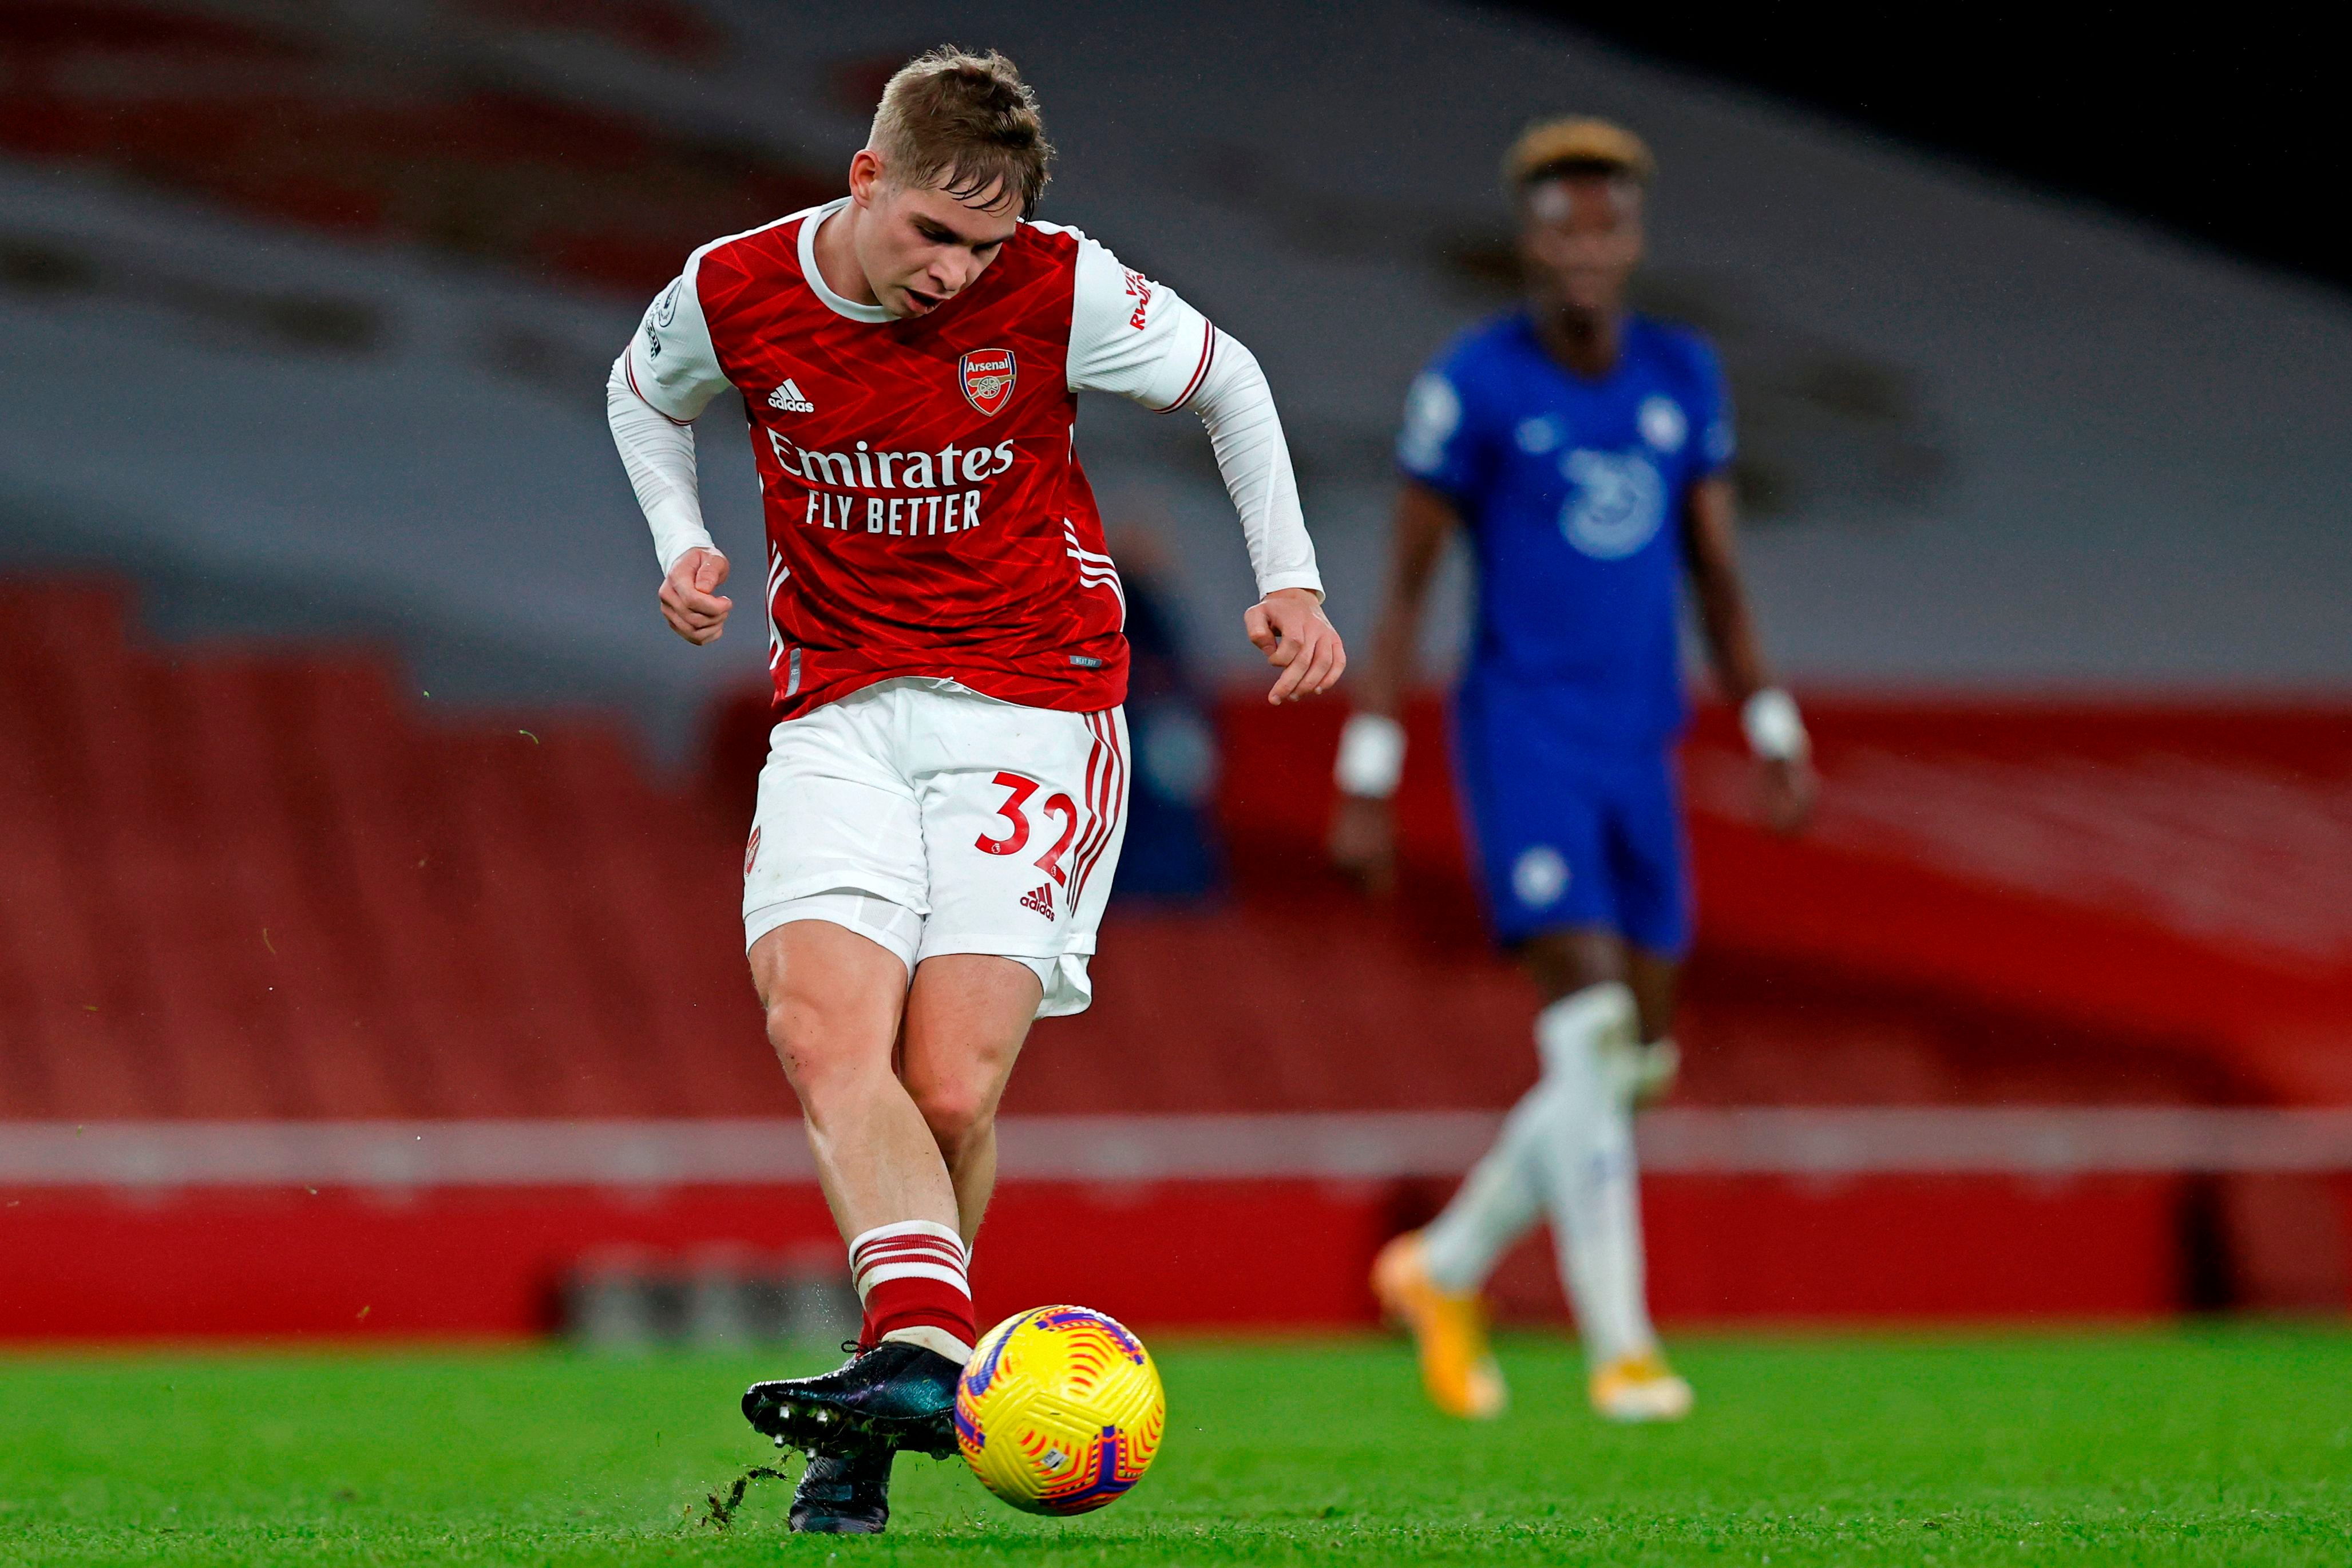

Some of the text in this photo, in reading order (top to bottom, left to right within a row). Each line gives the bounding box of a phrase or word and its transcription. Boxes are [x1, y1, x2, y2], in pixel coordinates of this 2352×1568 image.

[967, 358, 1009, 373] Arsenal
[767, 397, 815, 413] adidas
[765, 426, 1014, 488] Emirates
[806, 489, 980, 536] FLY BETTER
[974, 771, 1078, 889] 32
[1019, 896, 1055, 922] adidas
